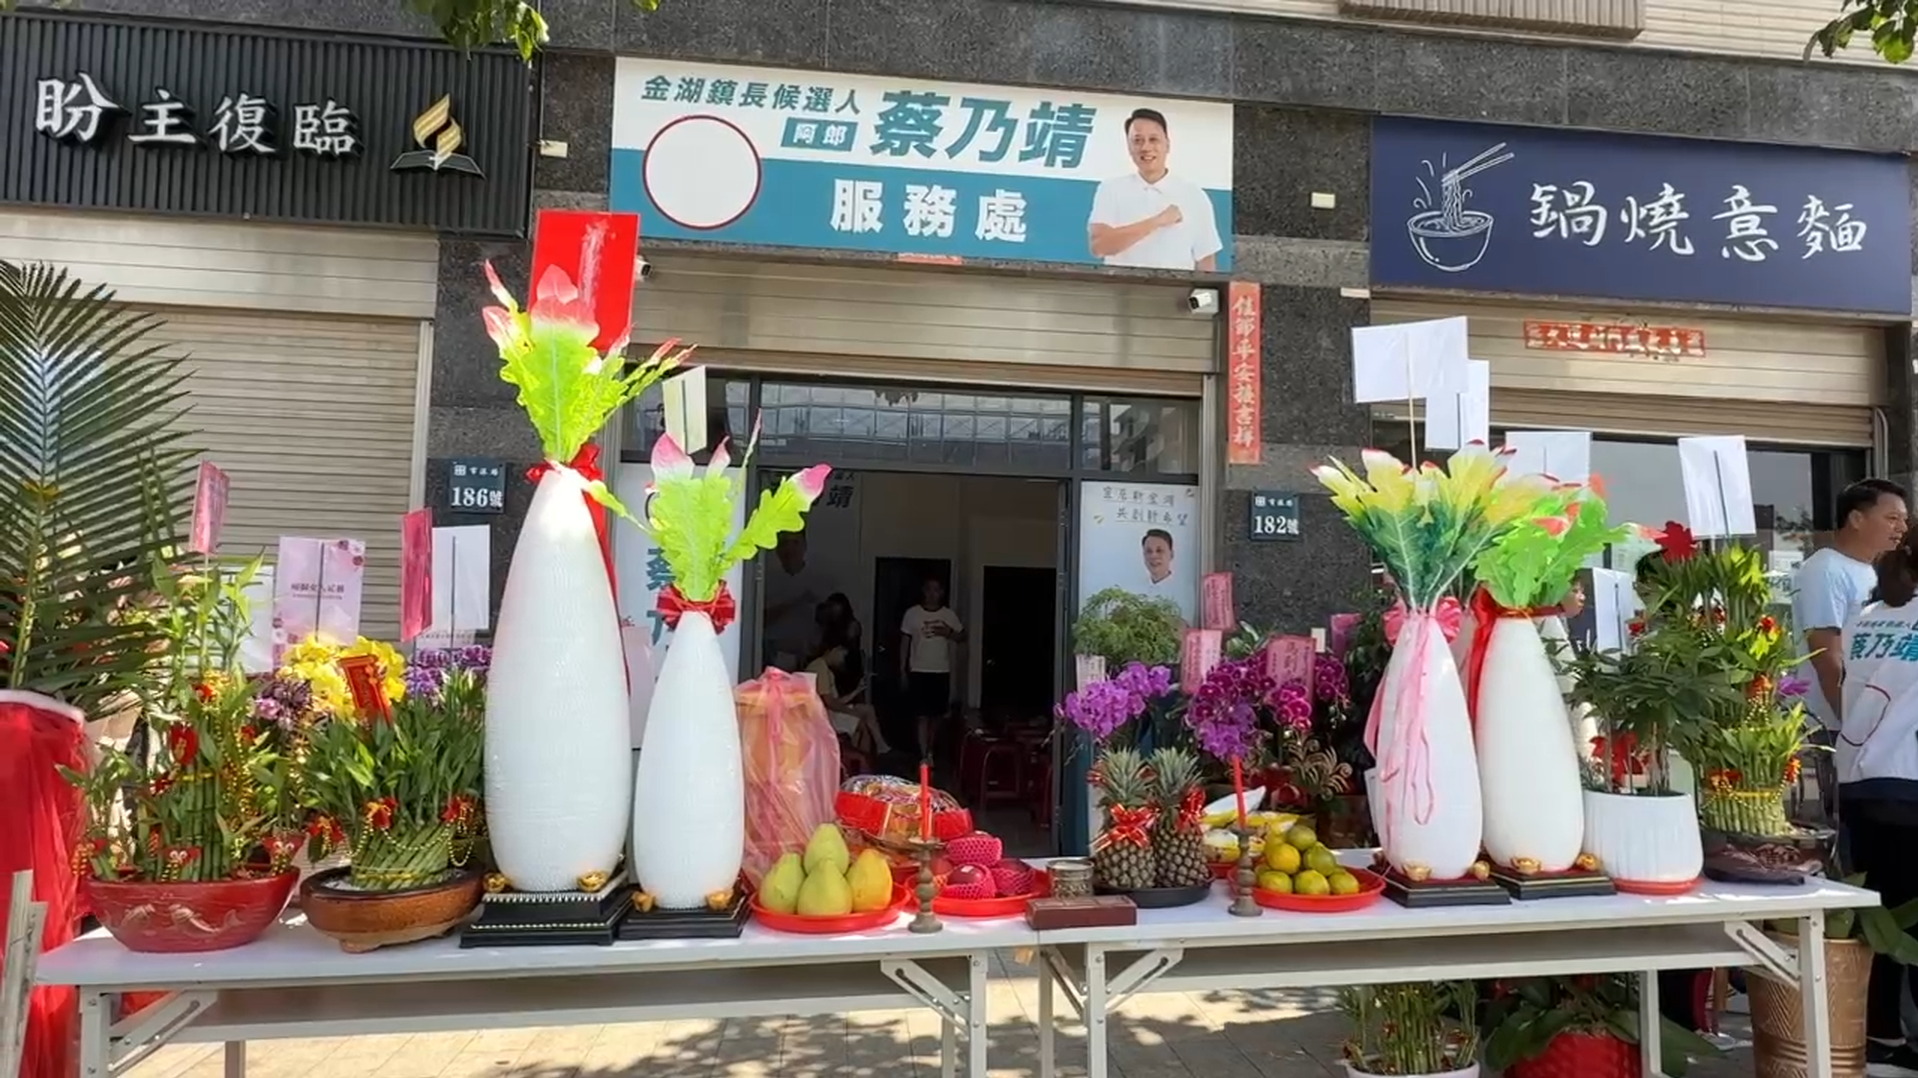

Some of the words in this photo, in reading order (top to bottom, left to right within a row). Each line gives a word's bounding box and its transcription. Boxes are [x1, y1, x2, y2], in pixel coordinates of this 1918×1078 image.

[36, 72, 355, 154] 盼主復臨
[641, 75, 862, 114] 金湖鎮長候選人
[792, 123, 848, 146] 阿郎
[869, 90, 1098, 168] 蔡乃靖
[830, 178, 1028, 242] 服務處
[1530, 181, 1867, 261] 鍋燒意麵
[451, 486, 503, 508] 186號
[1254, 515, 1300, 535] 182號
